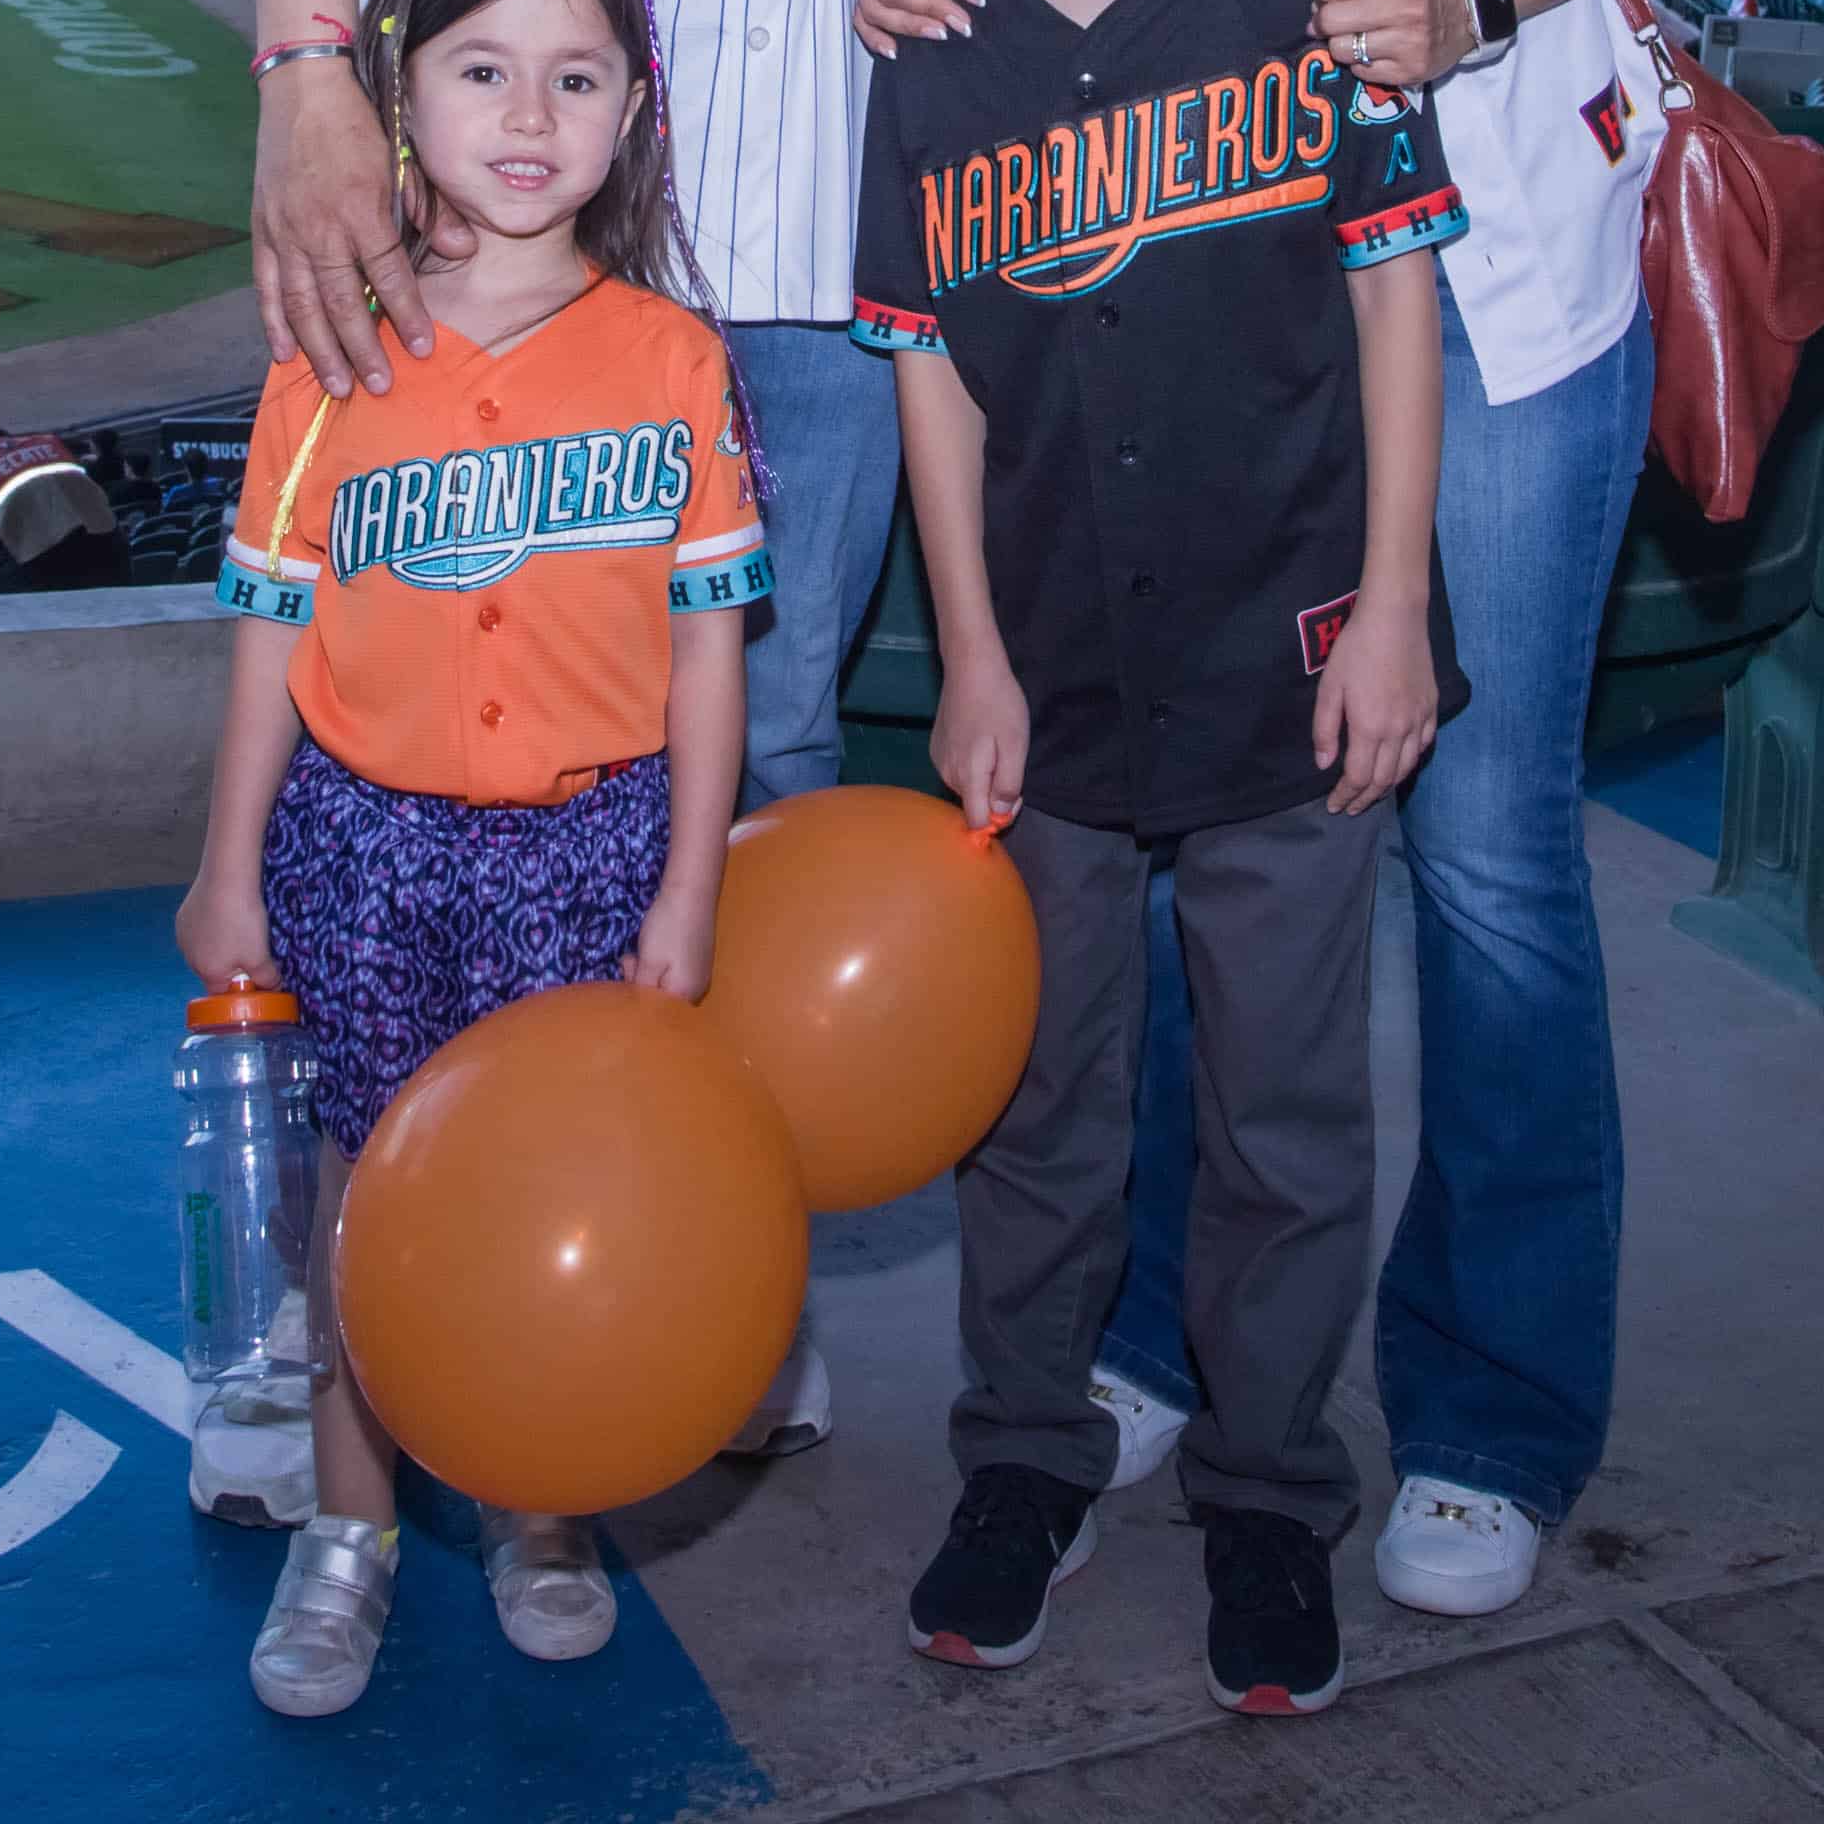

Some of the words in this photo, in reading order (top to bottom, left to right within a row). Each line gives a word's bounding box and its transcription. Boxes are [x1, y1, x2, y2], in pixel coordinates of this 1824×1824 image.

[921, 48, 1340, 301] NARANJEROS
[172, 441, 249, 459] STRBUCK
[330, 417, 695, 592] NARANJEROS
[231, 577, 258, 609] H
[273, 591, 304, 618] H
[706, 572, 734, 602] H
